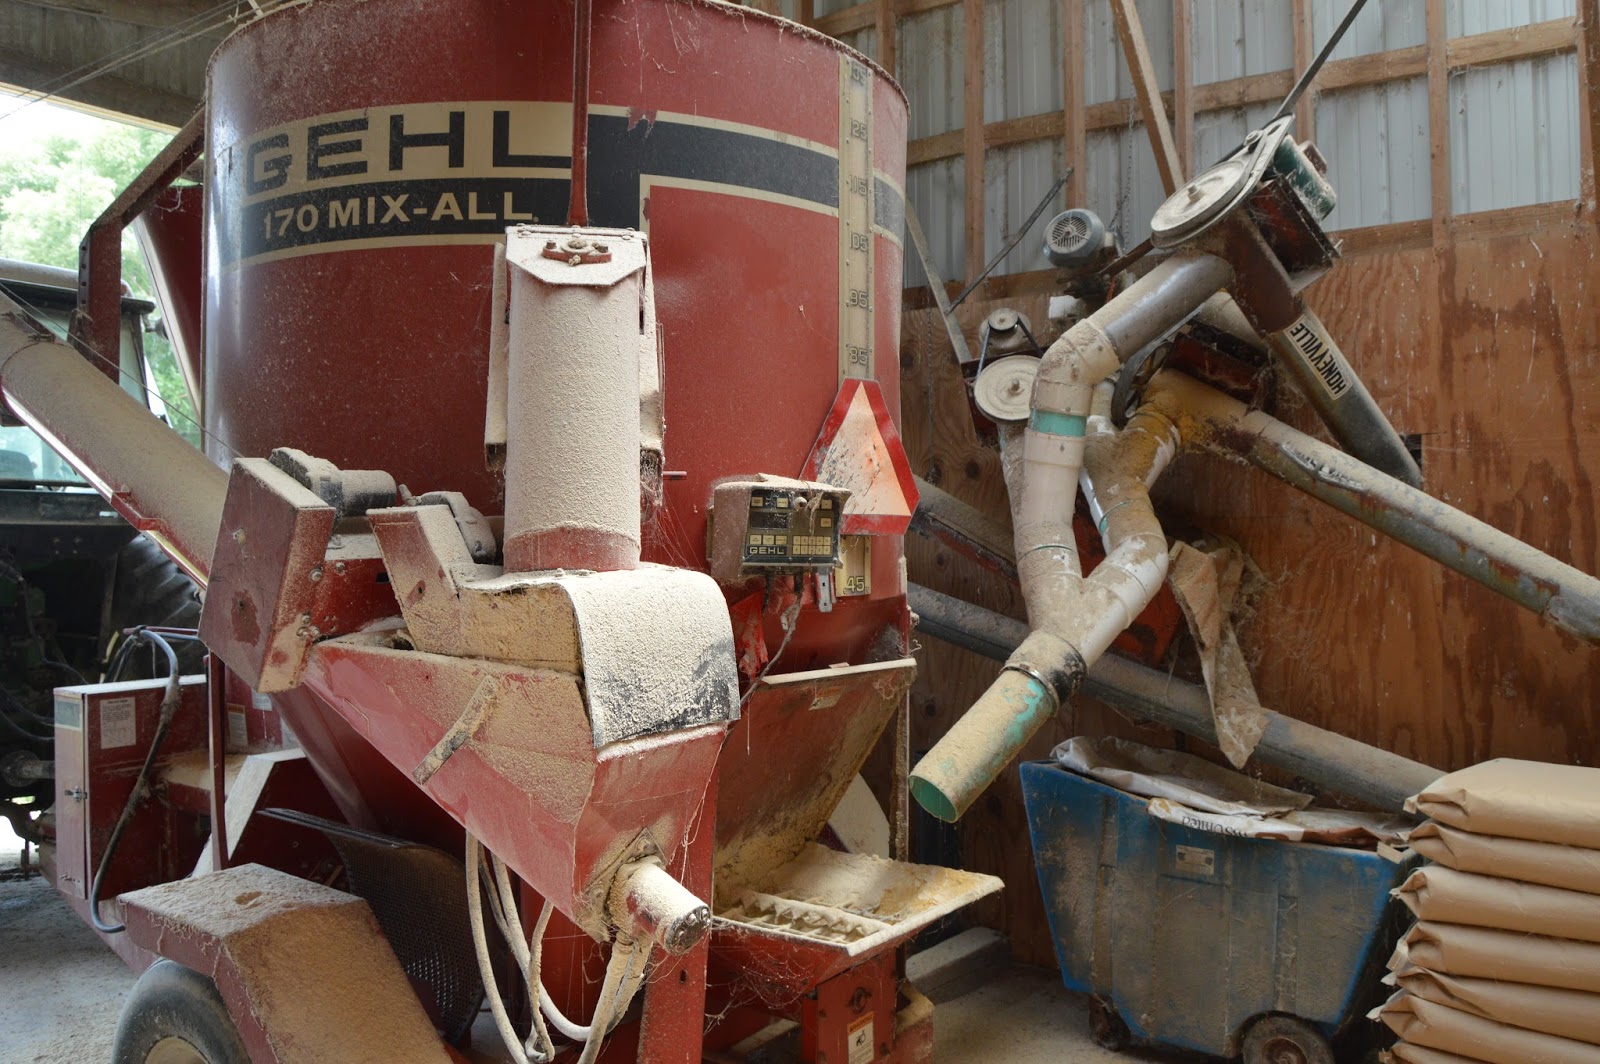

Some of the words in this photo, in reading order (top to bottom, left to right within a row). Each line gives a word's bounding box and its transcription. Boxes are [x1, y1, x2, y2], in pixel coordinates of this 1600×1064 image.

[248, 111, 572, 195] GEHL
[264, 205, 319, 240] 170
[328, 191, 533, 228] MIX-ALL
[849, 289, 868, 309] 95
[849, 346, 868, 366] 85
[1289, 322, 1347, 395] HONEYVILLE
[749, 546, 785, 555] GEHL
[846, 575, 866, 594] 45
